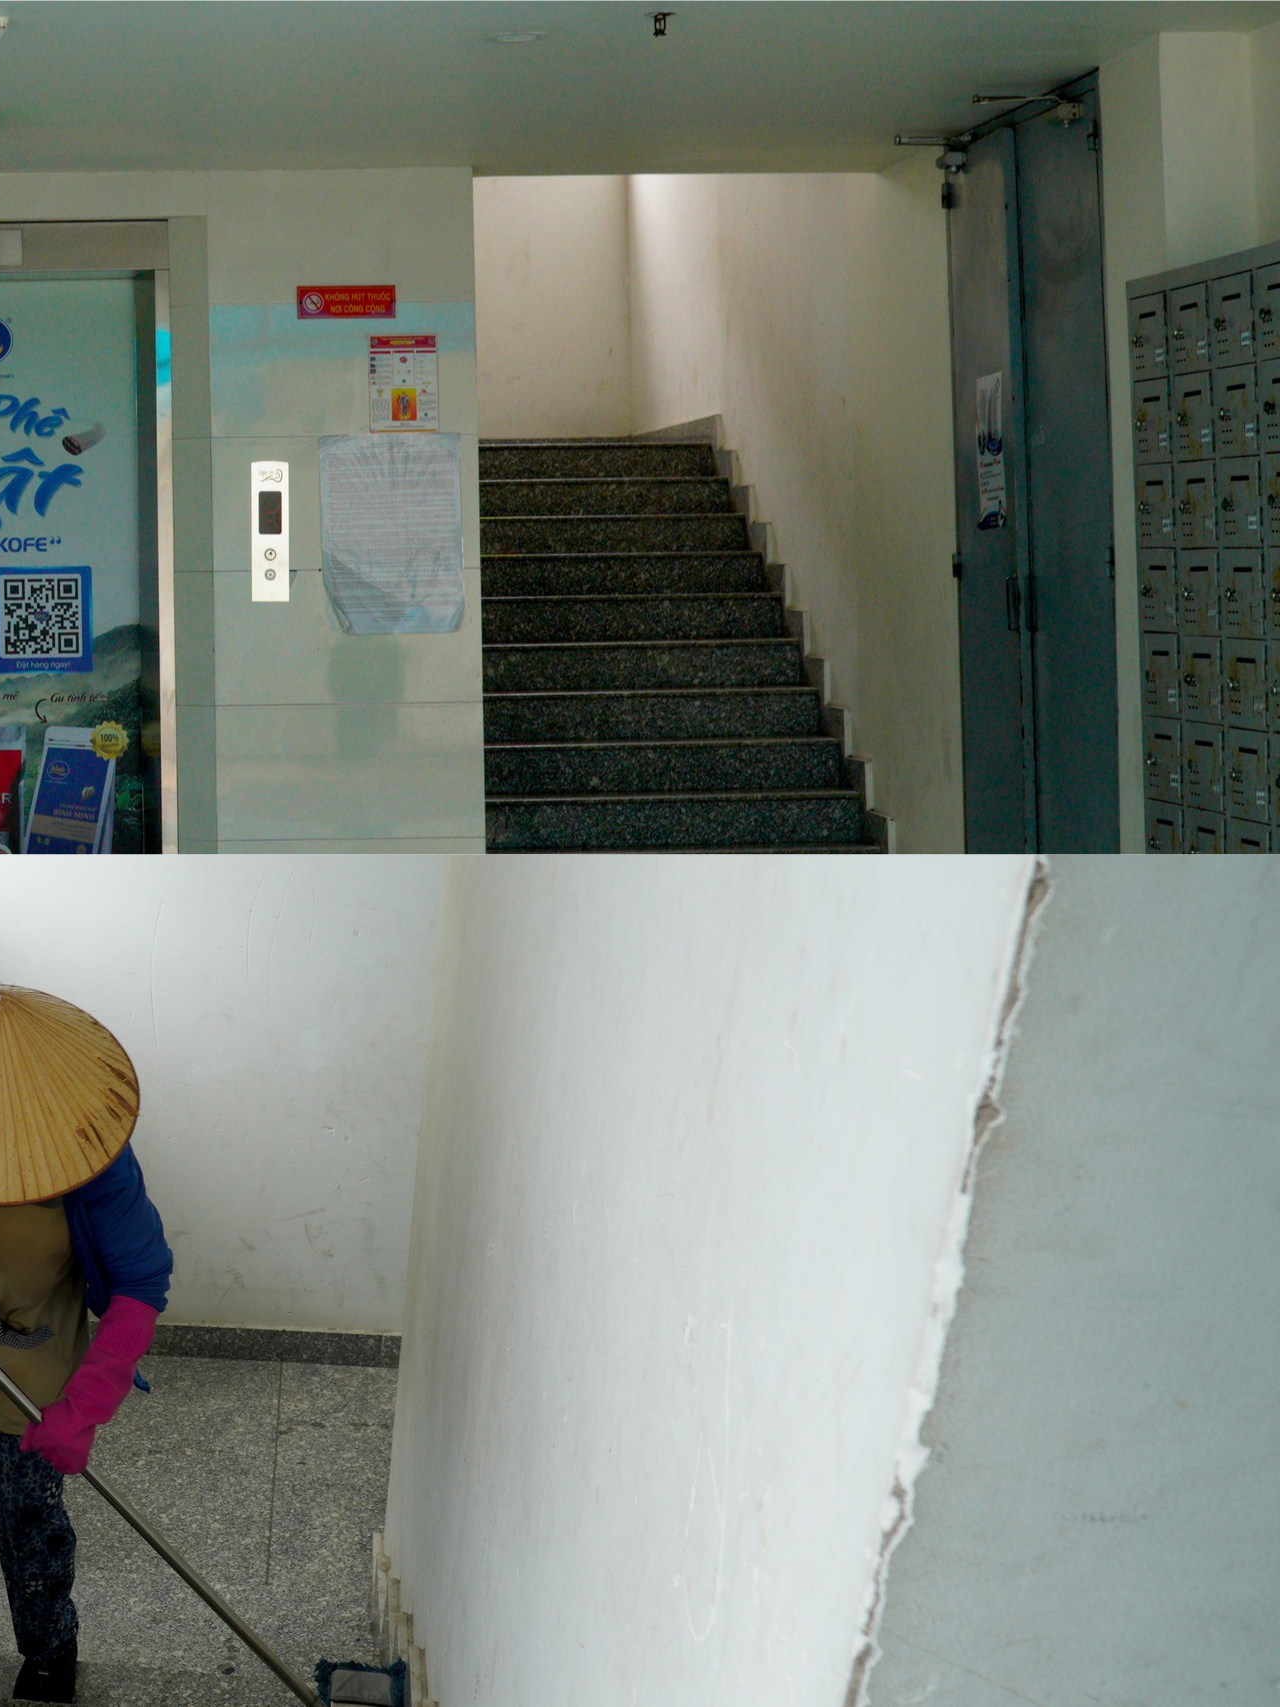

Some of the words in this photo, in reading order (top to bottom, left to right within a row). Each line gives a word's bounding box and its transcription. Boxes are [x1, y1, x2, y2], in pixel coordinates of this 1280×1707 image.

[325, 291, 350, 301] KHÔNG
[351, 291, 365, 301] HÚT
[368, 289, 391, 300] THUỐC
[330, 305, 342, 313] NƠI
[343, 303, 364, 313] CÔNG
[365, 304, 386, 314] CỘNG
[16, 661, 29, 670] Đặt
[31, 661, 49, 670] hàng
[50, 661, 71, 670] ngay!
[50, 692, 64, 703] Gu
[67, 692, 86, 703] tinh
[100, 733, 119, 742] 100%
